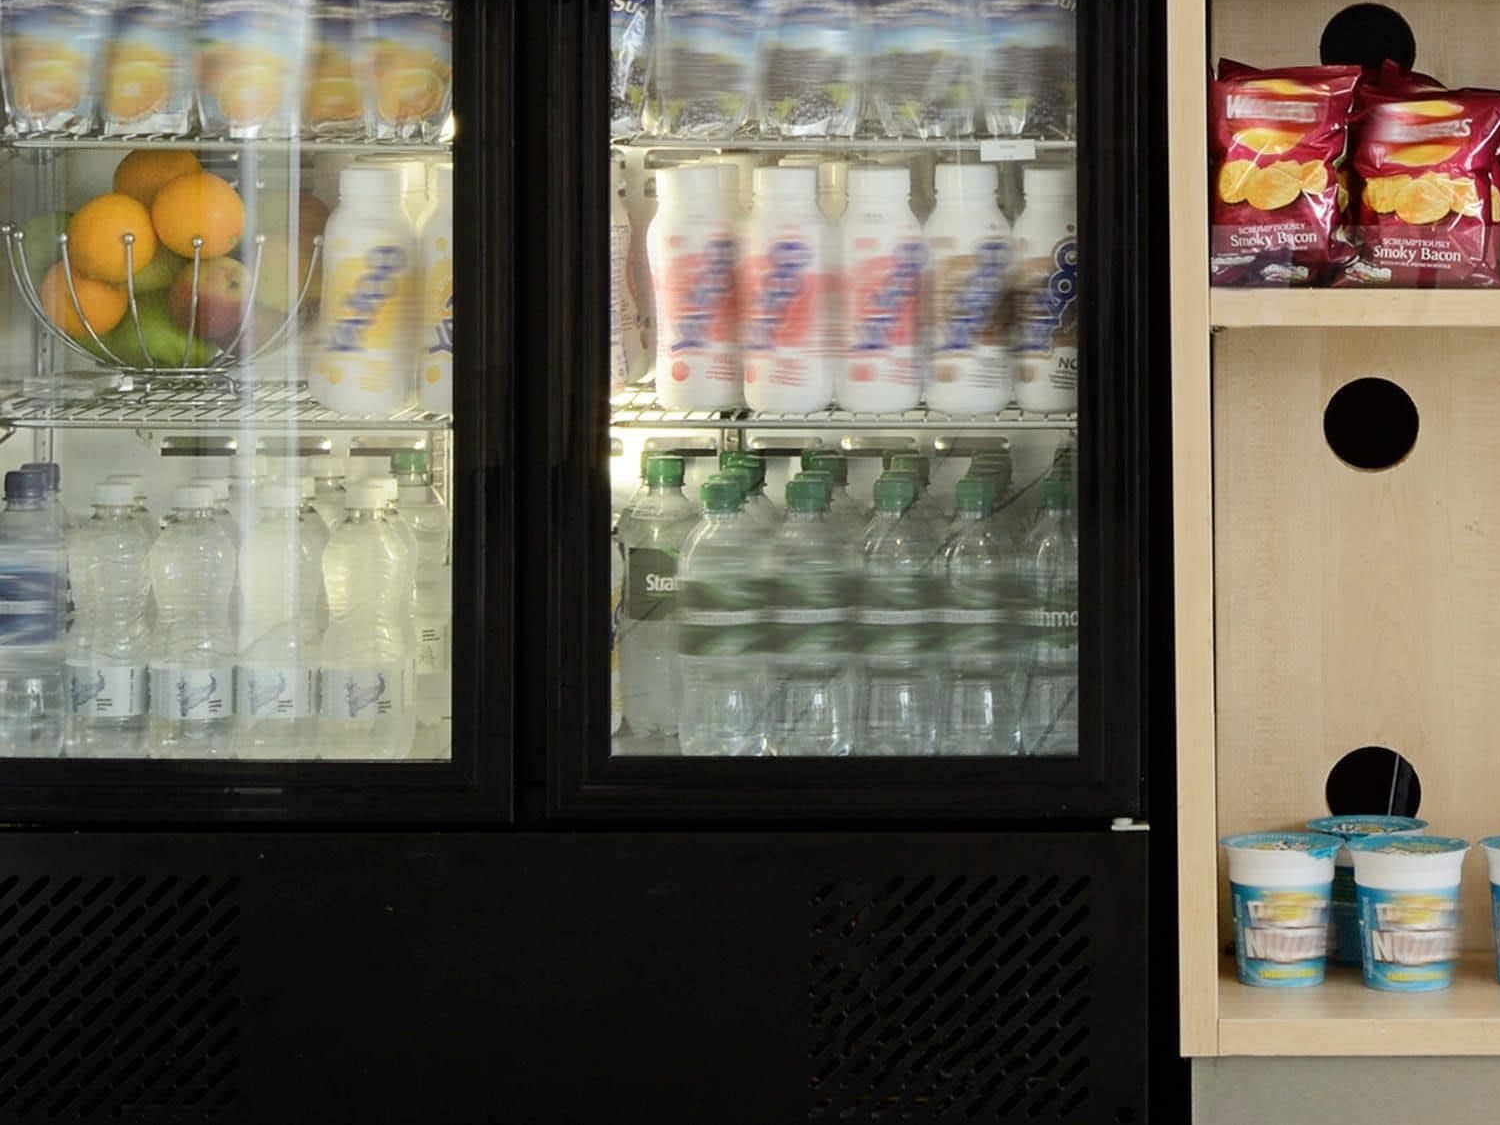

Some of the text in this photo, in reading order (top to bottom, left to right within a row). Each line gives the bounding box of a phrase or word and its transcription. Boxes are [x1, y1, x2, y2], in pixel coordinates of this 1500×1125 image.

[1230, 233, 1272, 248] Smoky
[1277, 231, 1318, 246] Bacon
[1373, 246, 1462, 263] Smoky Bacon
